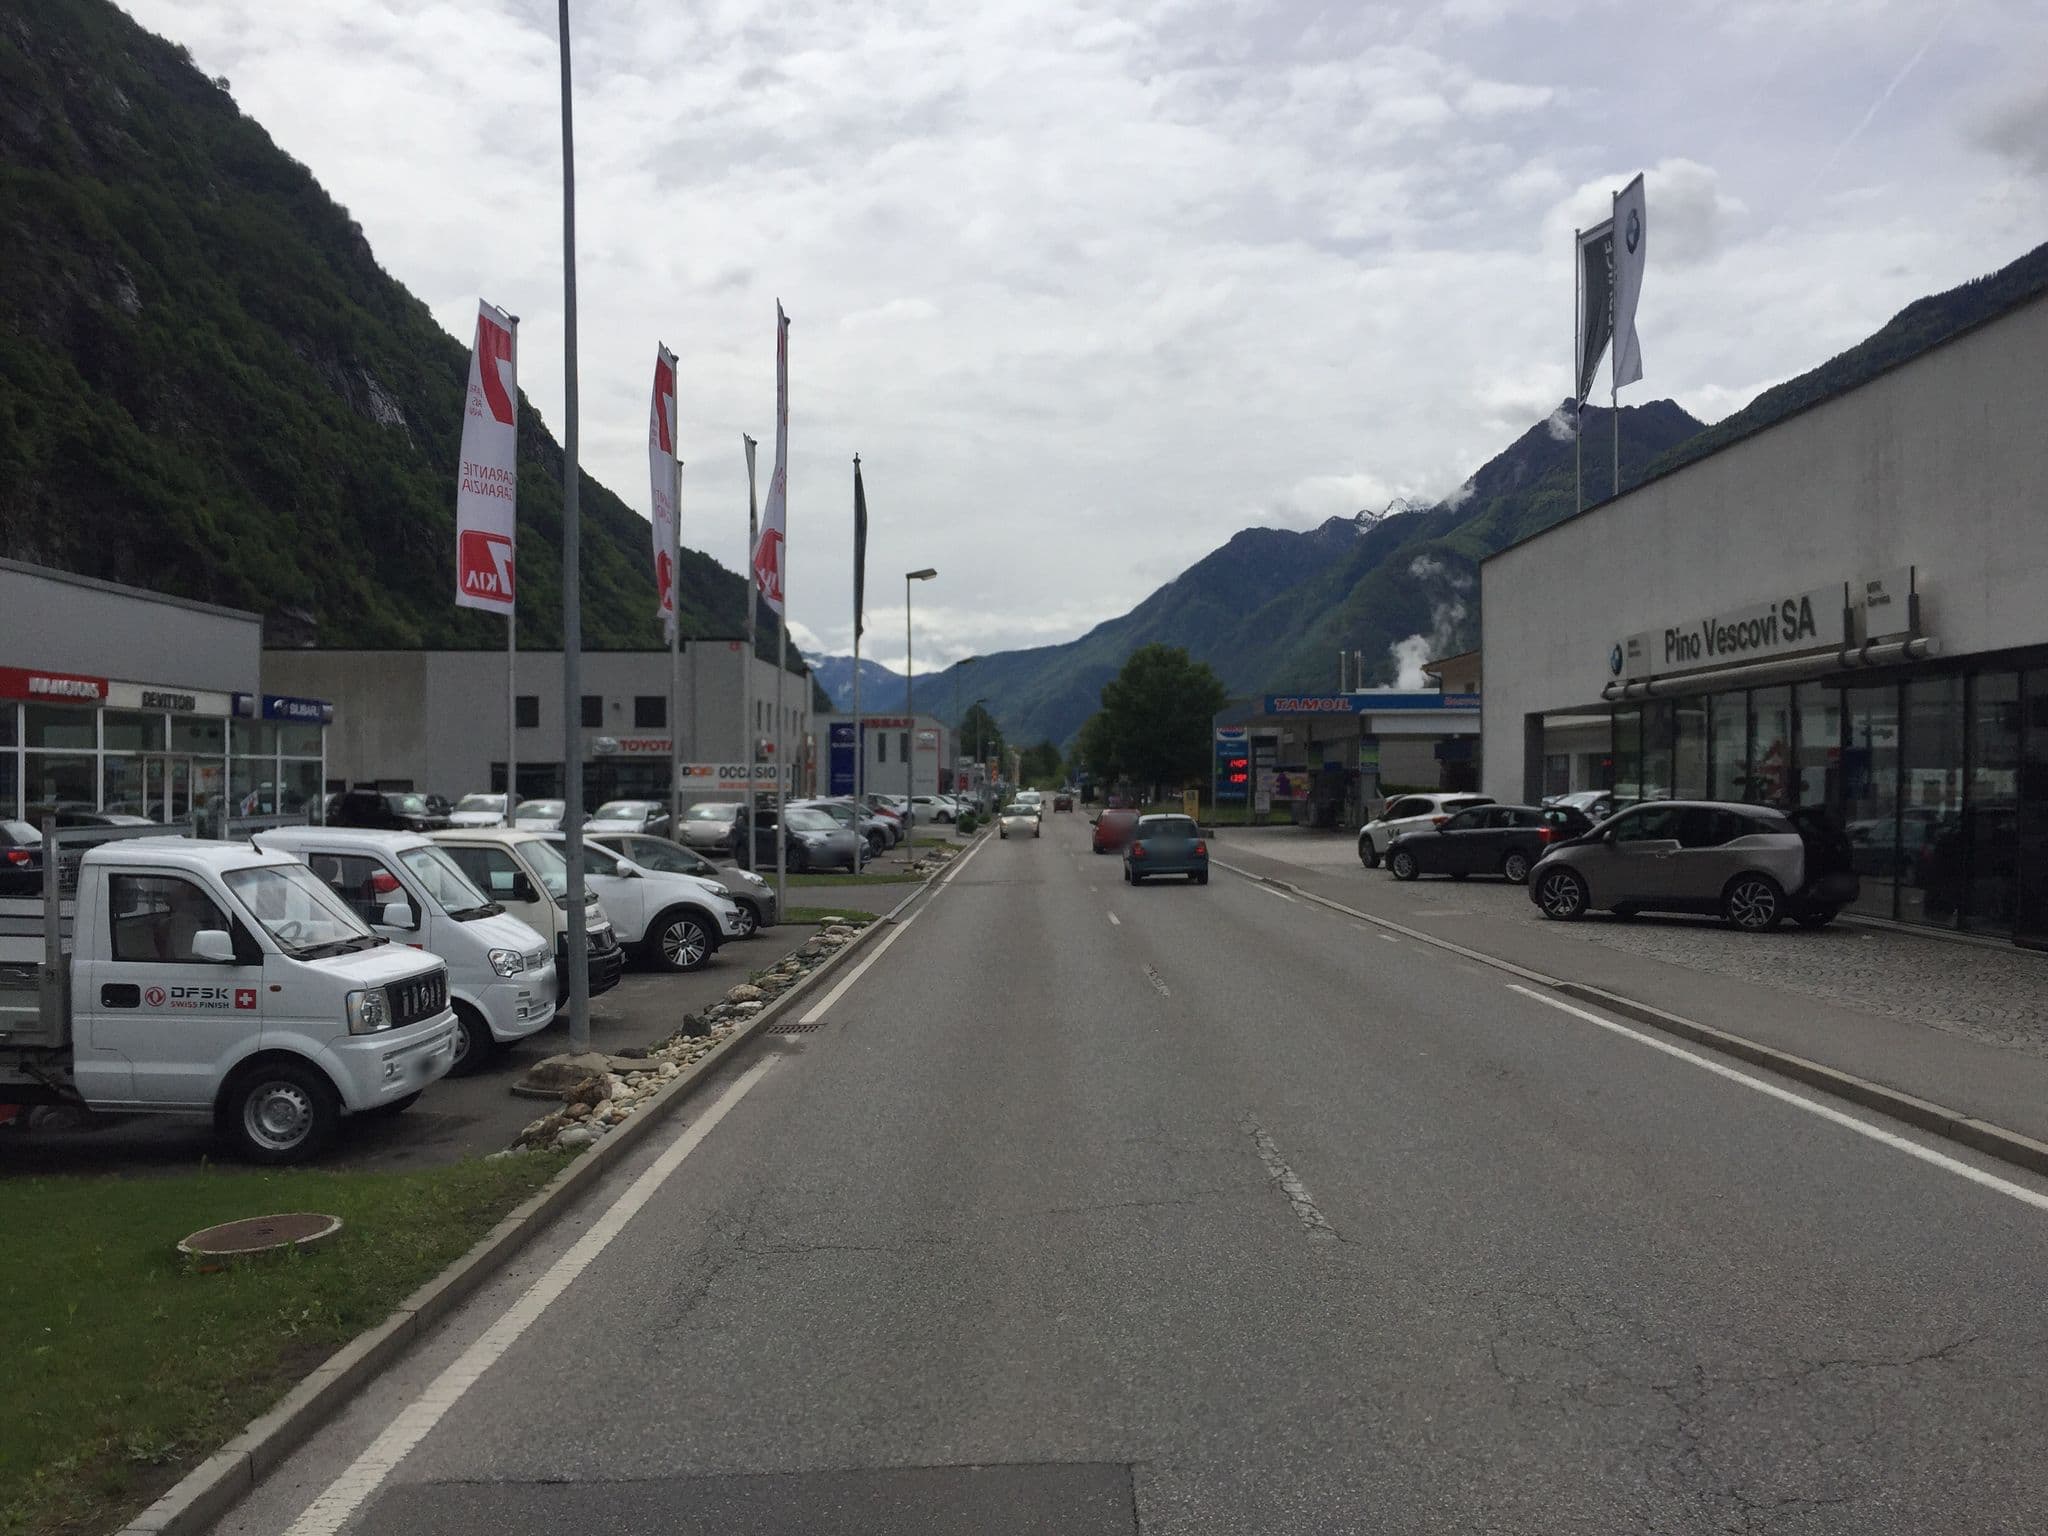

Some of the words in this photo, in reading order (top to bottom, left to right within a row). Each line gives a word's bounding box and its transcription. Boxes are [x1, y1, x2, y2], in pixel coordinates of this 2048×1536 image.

[1664, 627, 1701, 664] Pino
[1703, 605, 1778, 656] Vescovi
[1782, 595, 1816, 642] SA
[1274, 698, 1353, 712] TAMOIL
[170, 986, 229, 999] DFSK
[170, 1000, 198, 1008] SWISS
[199, 1001, 229, 1009] FINISH
